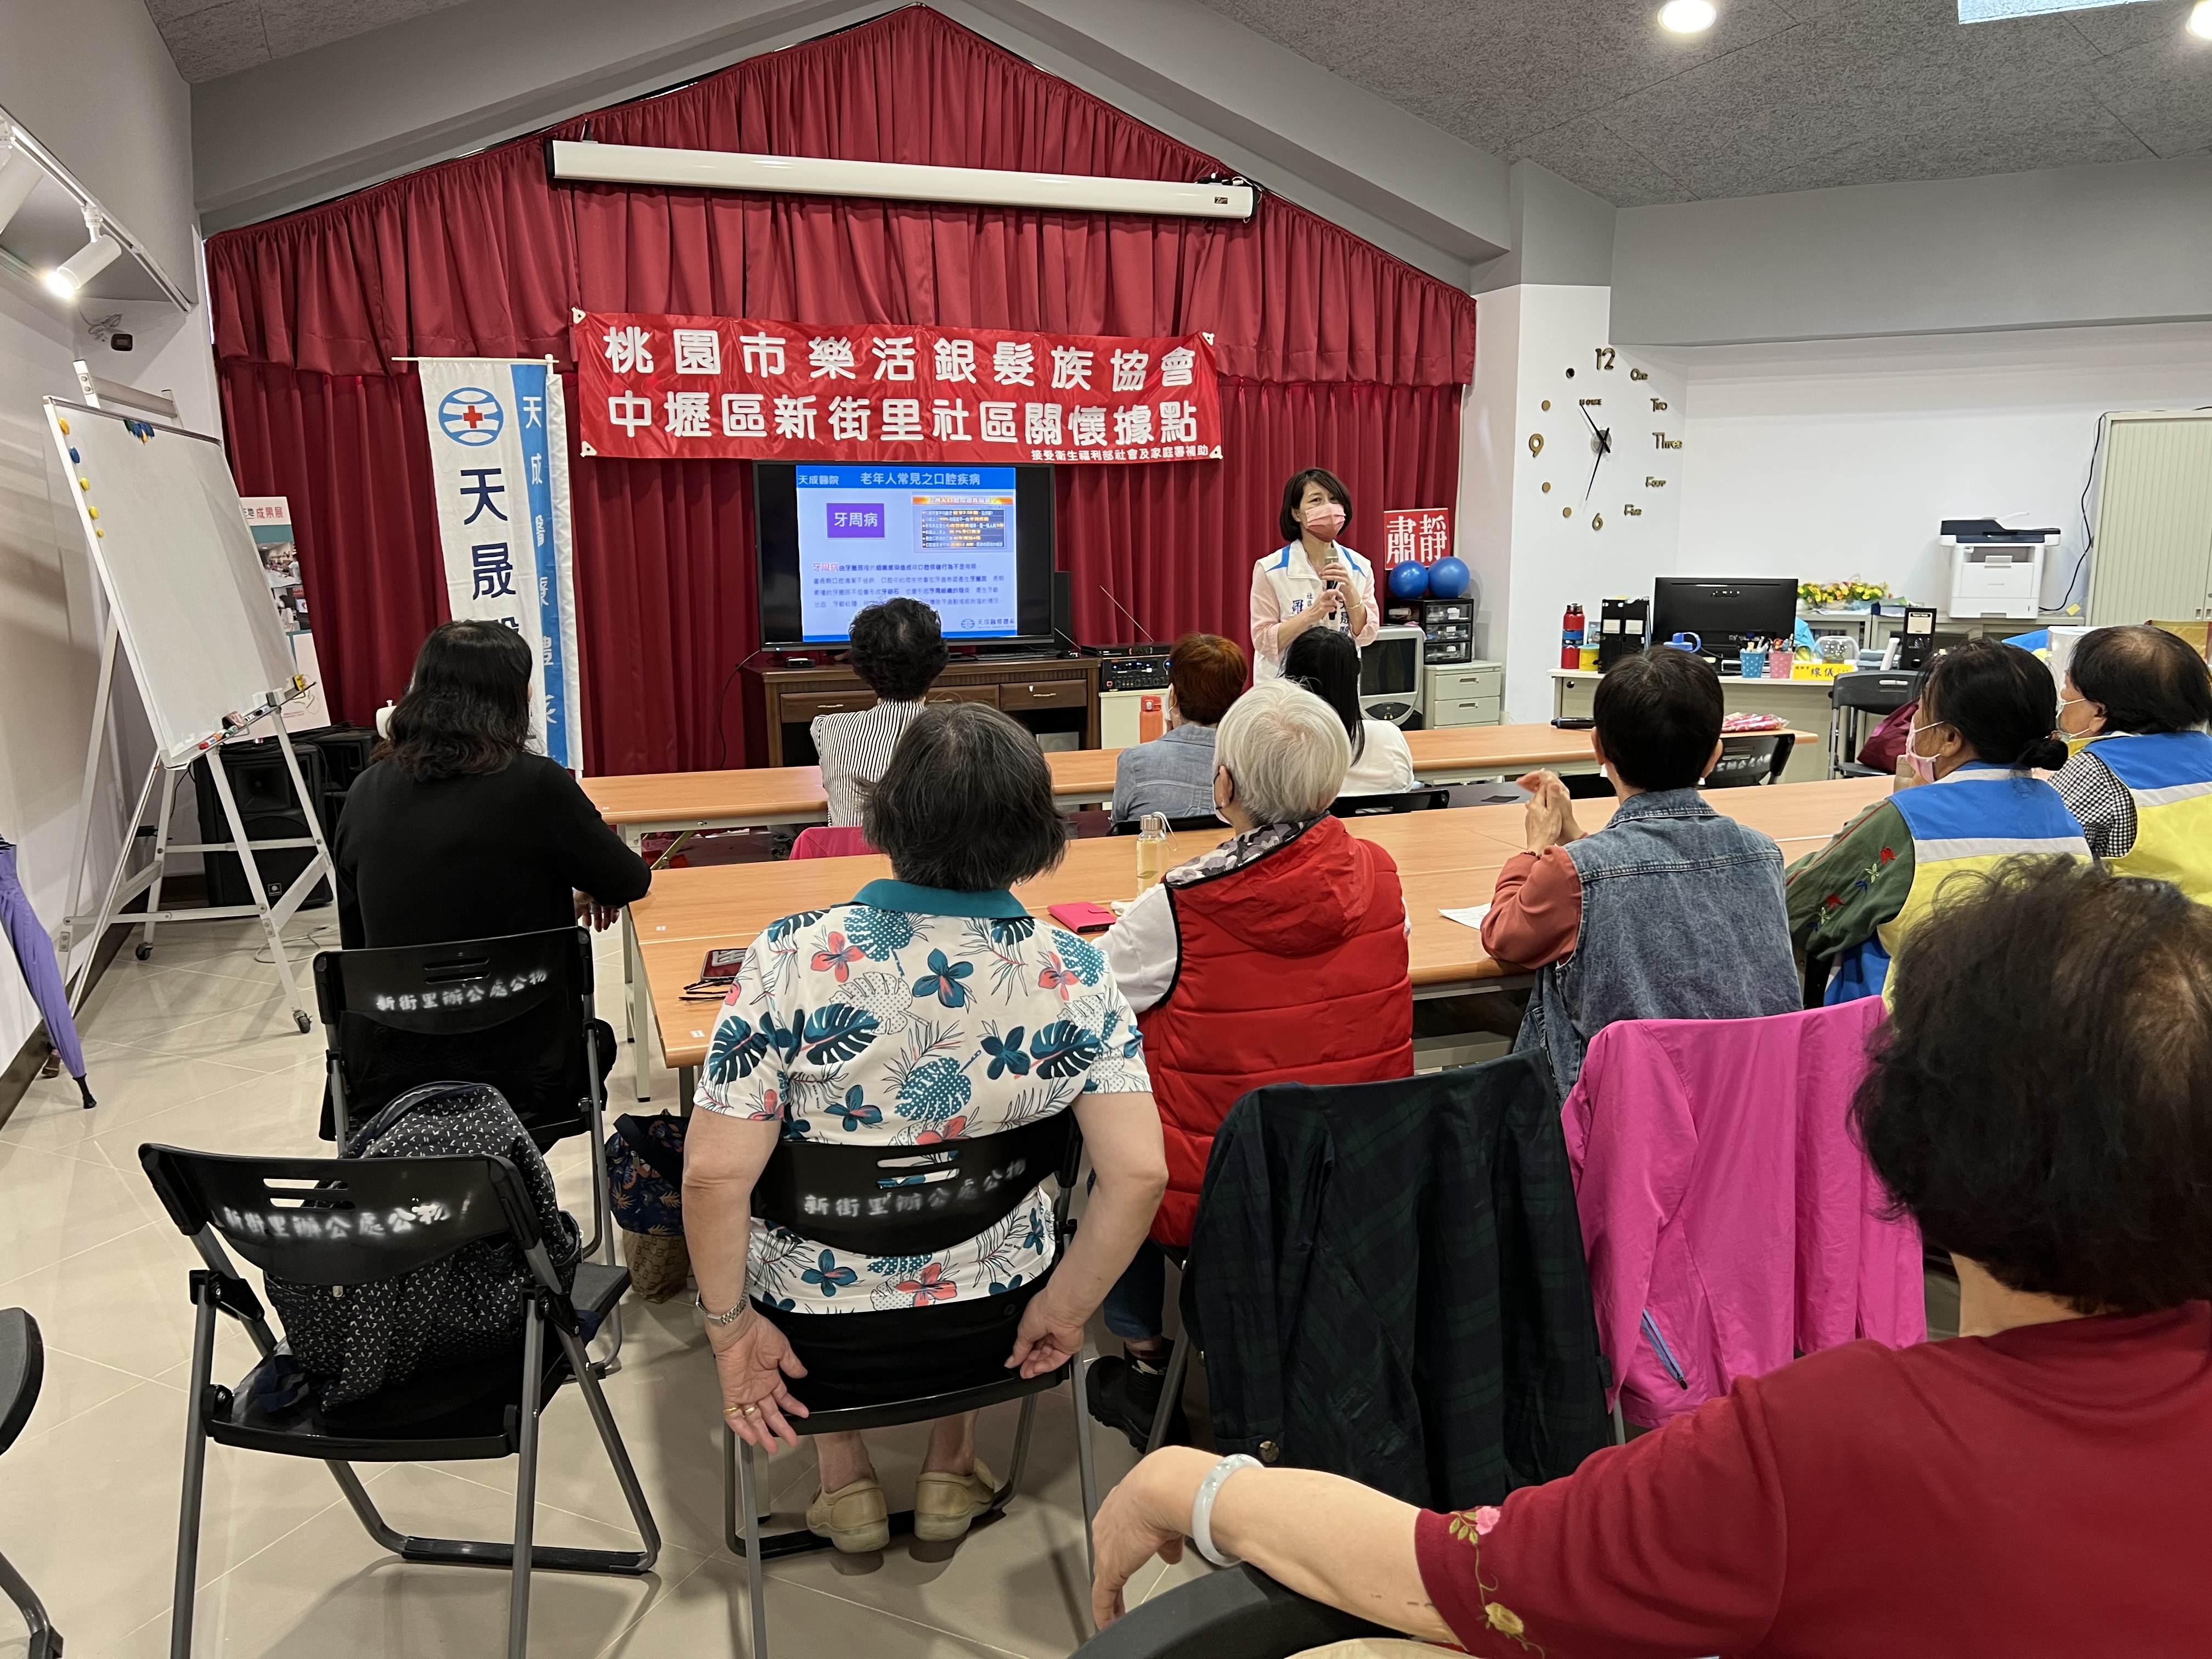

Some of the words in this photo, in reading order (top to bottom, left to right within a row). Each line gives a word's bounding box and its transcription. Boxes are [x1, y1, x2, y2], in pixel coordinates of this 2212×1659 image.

[605, 326, 1196, 392] 桃園市樂活銀髮族協會
[1595, 348, 1616, 370] 12
[607, 390, 1199, 447] 中壢區新街里社區關懷據點
[1031, 444, 1209, 461] 接受衛生福利部社會及家庭署補助
[1529, 433, 1544, 458] 9
[798, 475, 839, 486] 天成醫院
[860, 472, 980, 486] 老年人常見之口腔疾病
[834, 512, 878, 528] 牙周病
[1592, 513, 1604, 531] 6
[1386, 514, 1447, 564] 肅靜
